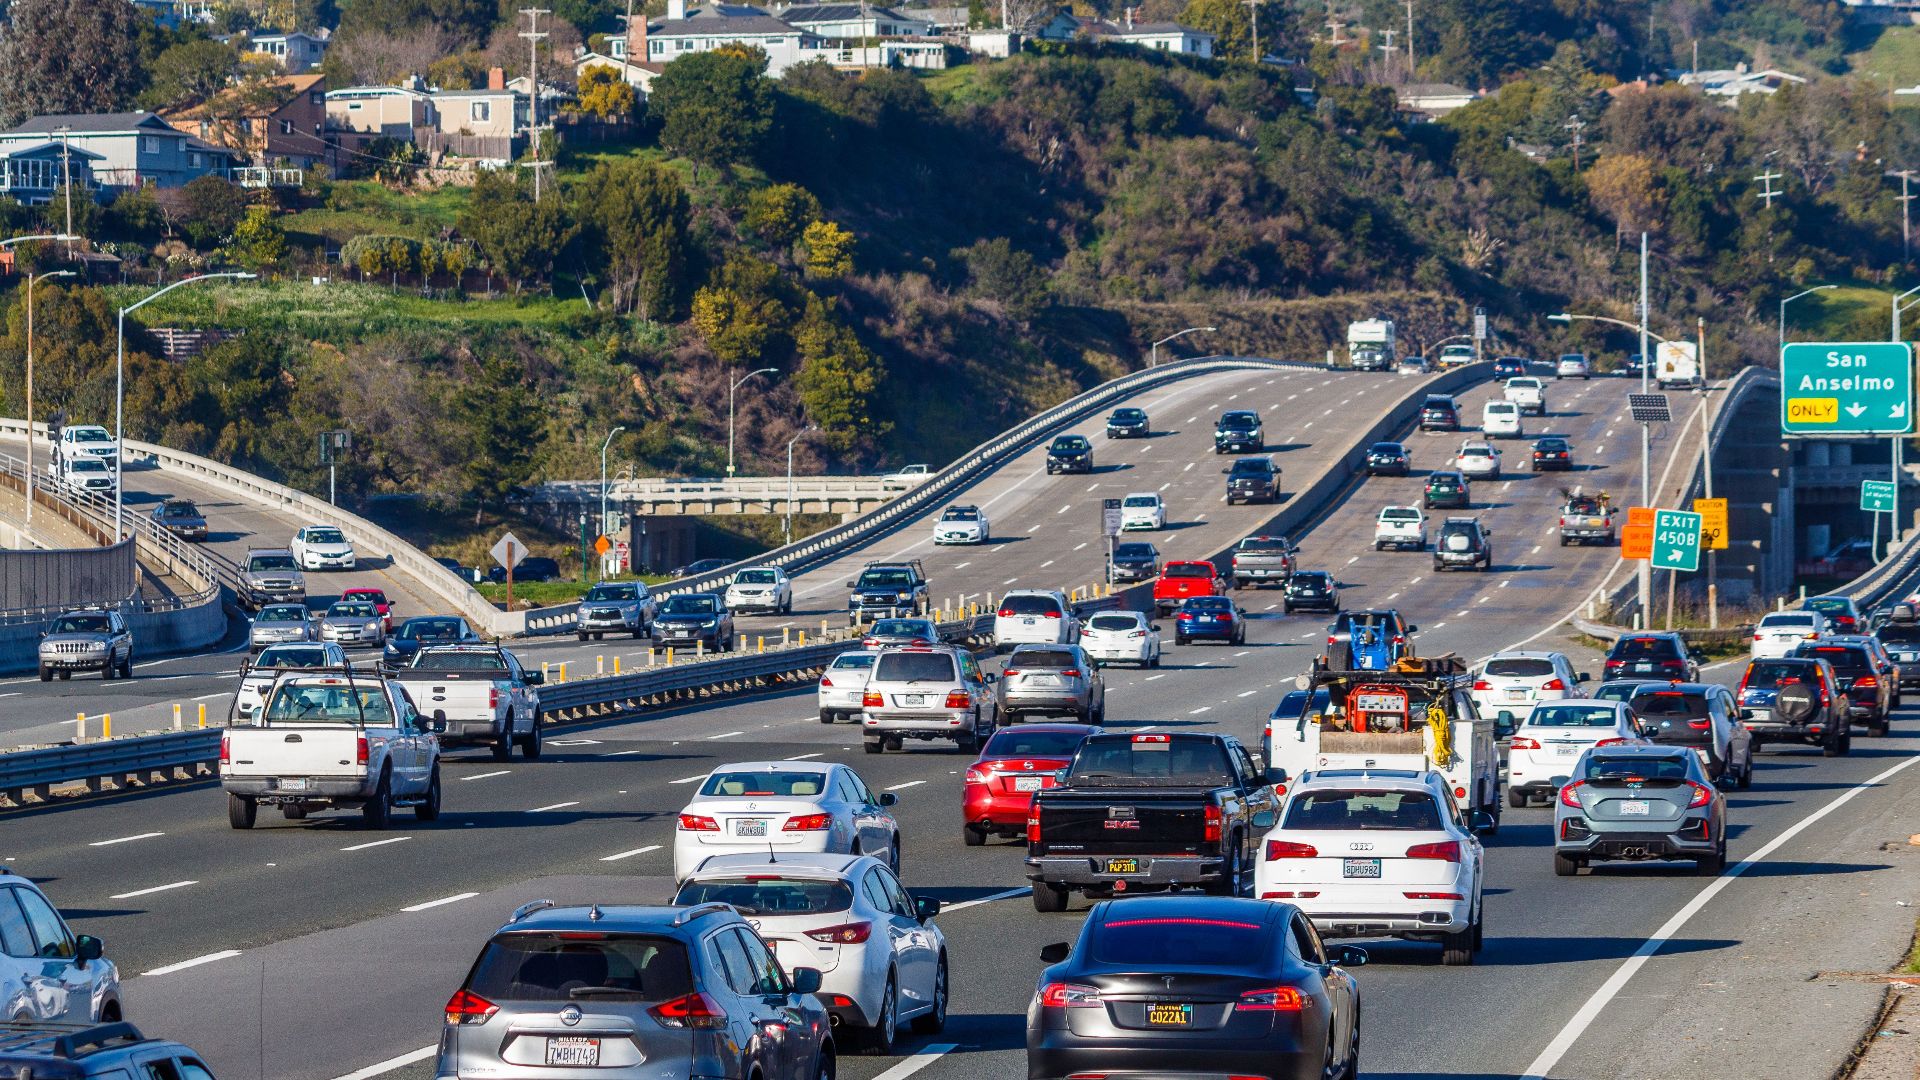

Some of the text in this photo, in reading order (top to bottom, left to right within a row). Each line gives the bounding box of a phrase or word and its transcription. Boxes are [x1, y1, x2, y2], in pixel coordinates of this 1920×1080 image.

[1826, 351, 1867, 367] San
[1798, 374, 1895, 391] Anselmo
[1791, 404, 1834, 417] ONLY
[1697, 501, 1723, 509] CAUTION
[1660, 514, 1697, 529] EXIT
[1657, 530, 1696, 546] 450B
[1104, 820, 1140, 829] GMC
[550, 1047, 596, 1062] 7WBH748
